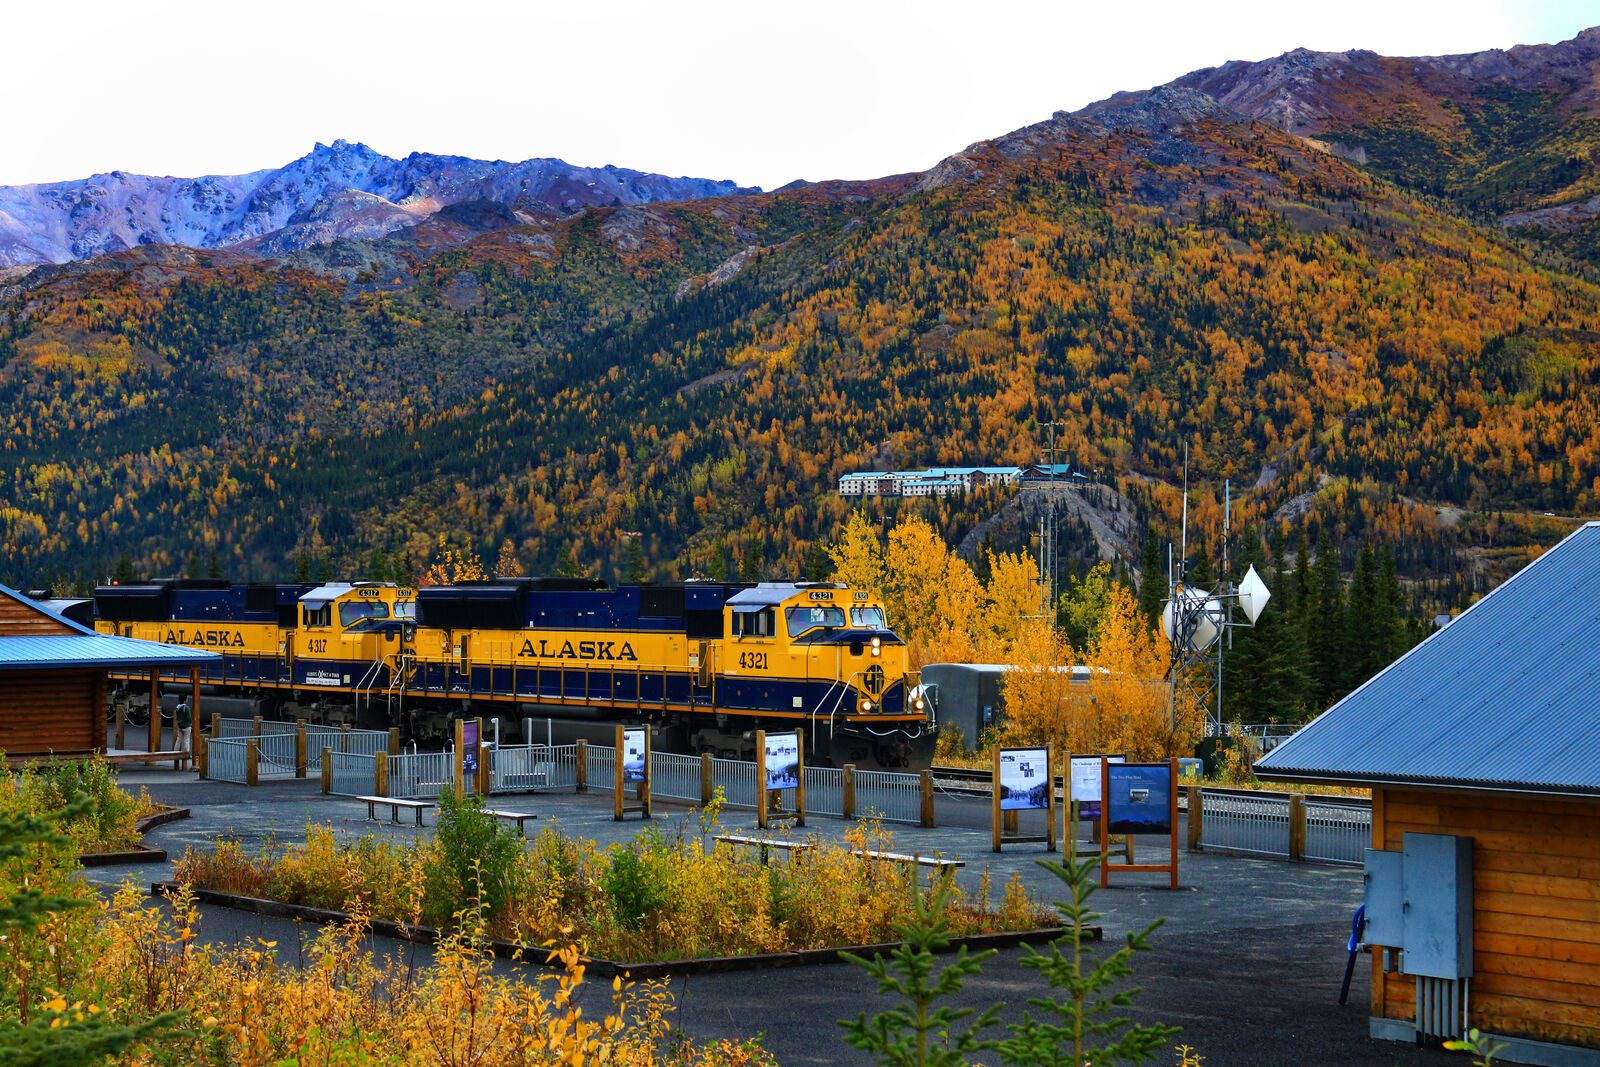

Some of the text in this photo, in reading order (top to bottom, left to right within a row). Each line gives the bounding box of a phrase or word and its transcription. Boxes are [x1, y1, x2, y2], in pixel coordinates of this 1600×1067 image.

[811, 592, 831, 600] 4321
[164, 630, 245, 647] ALASKA
[308, 639, 327, 653] 4317
[518, 639, 638, 661] ALASKA
[739, 652, 768, 670] 4321
